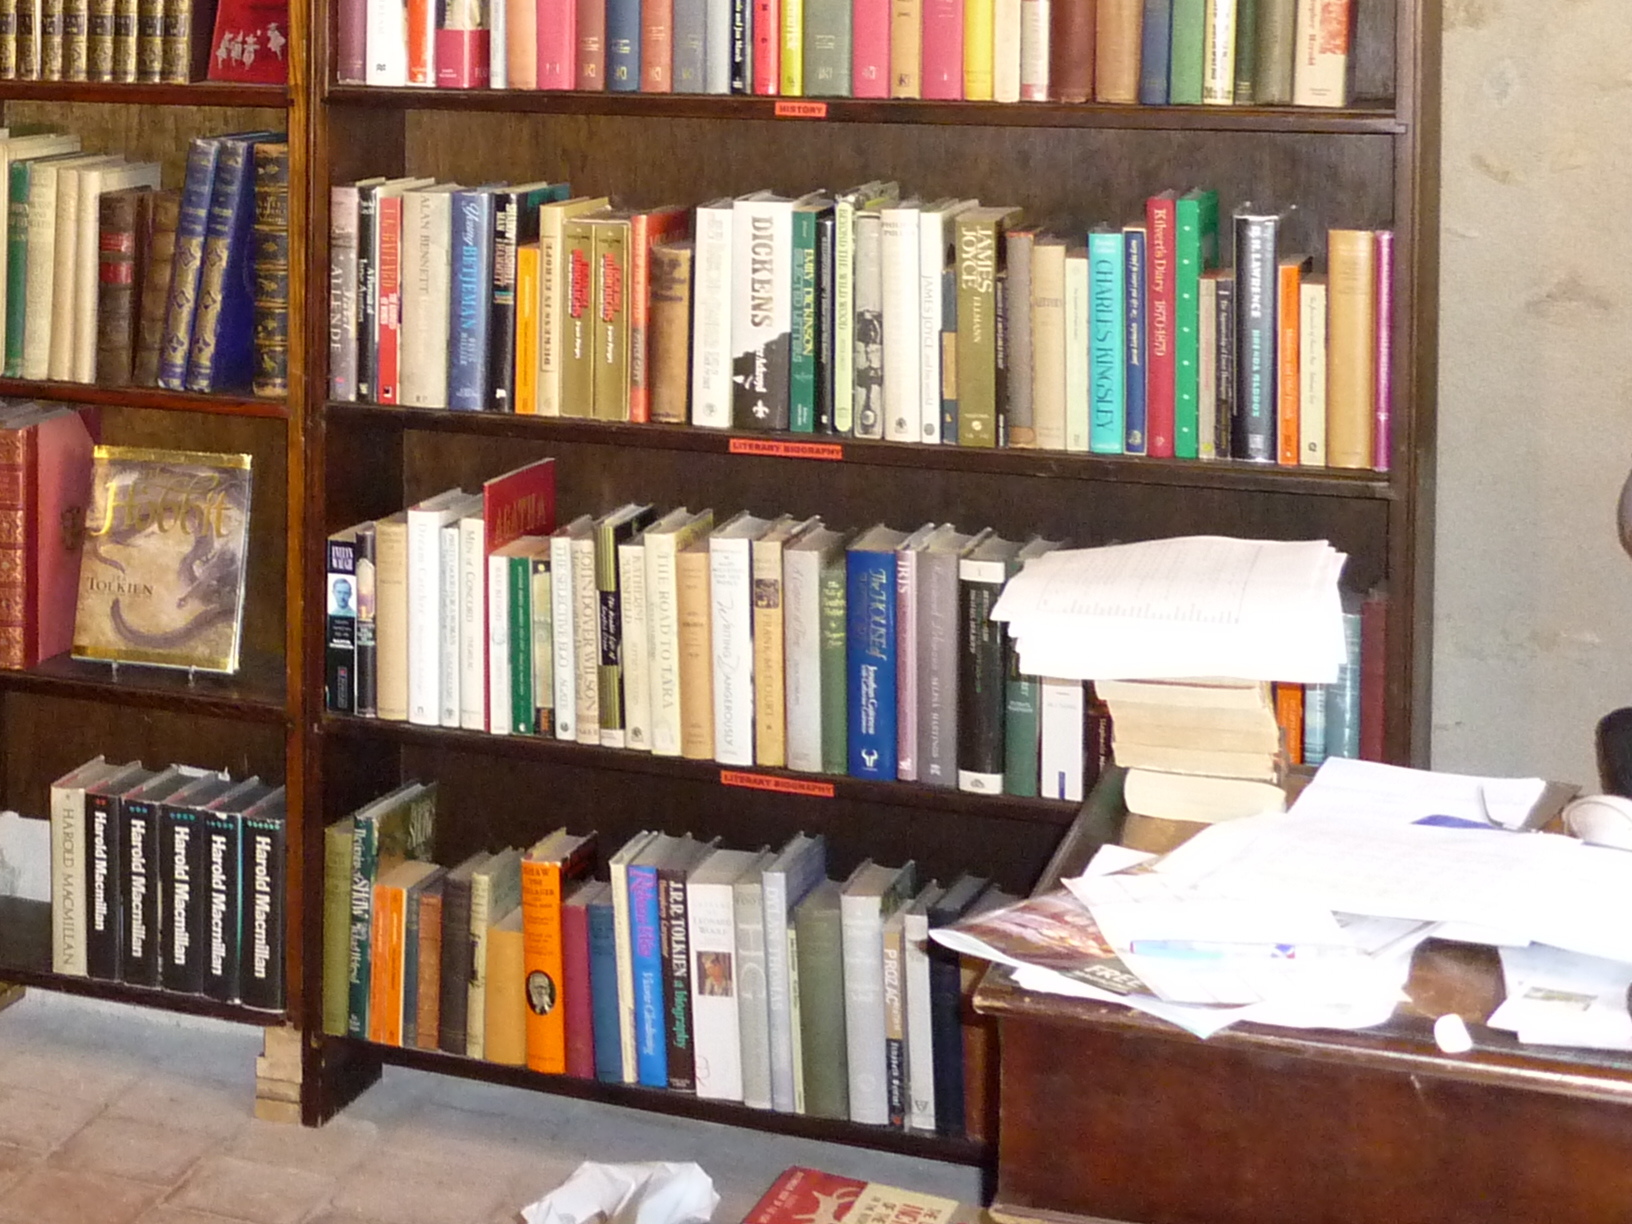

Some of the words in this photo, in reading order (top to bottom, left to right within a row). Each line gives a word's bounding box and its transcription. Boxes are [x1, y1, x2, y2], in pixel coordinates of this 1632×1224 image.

[779, 104, 823, 114] HISTORY
[418, 194, 430, 230] ALAN
[461, 199, 480, 247] Young
[838, 207, 849, 247] BEYOND
[1152, 207, 1167, 258] Kilvert's
[418, 233, 430, 294] BENNETT
[750, 215, 775, 329] DICKENS
[802, 248, 814, 281] EMILY
[838, 248, 849, 269] THE
[838, 271, 849, 299] WILD
[961, 226, 978, 290] JOYCE
[976, 225, 993, 294] JAMES
[1151, 259, 1167, 292] Diary
[330, 264, 344, 353] ALLENDE
[460, 245, 478, 329] BETJEMAN
[921, 274, 934, 315] JAMES
[1095, 259, 1119, 342] CHARLES
[803, 286, 815, 357] DICKINSON
[838, 300, 849, 331] WOOD
[921, 315, 935, 351] JOYCE
[972, 296, 983, 344] ELLMANN
[752, 358, 768, 393] Ackroyd
[1095, 346, 1119, 432] KINGSLEY
[732, 441, 781, 454] LITERARY
[784, 444, 842, 458] BIOGRAPHY
[89, 474, 235, 539] Hobbit
[86, 576, 155, 597] TOLKIEN
[464, 571, 476, 623] CONCORD
[580, 549, 594, 594] JOHN
[896, 559, 909, 594] IRIS
[581, 595, 596, 647] DOVER
[657, 589, 672, 637] ROAD
[868, 591, 888, 648] HOUSE
[659, 640, 672, 661] TO
[581, 649, 597, 713] WILSON
[660, 664, 674, 710] TARA
[723, 773, 772, 786] LITERARY
[773, 778, 834, 794] BIOGRAPHY
[61, 807, 75, 868] HAROLD
[94, 810, 108, 859] Harold
[130, 818, 146, 873] Harold
[173, 825, 189, 880] Harold
[210, 834, 227, 890] Harold
[254, 835, 271, 891] Harold
[62, 873, 75, 966] MACMILLAN
[95, 859, 107, 931] Macmillan
[131, 875, 146, 958] Macmillan
[173, 881, 189, 965] Macmillan
[210, 892, 226, 977] Macmillan
[254, 892, 270, 979] Macmillan
[671, 917, 687, 977] TOLKIEN
[884, 948, 900, 1004] PROZAC
[672, 989, 690, 1049] biography
